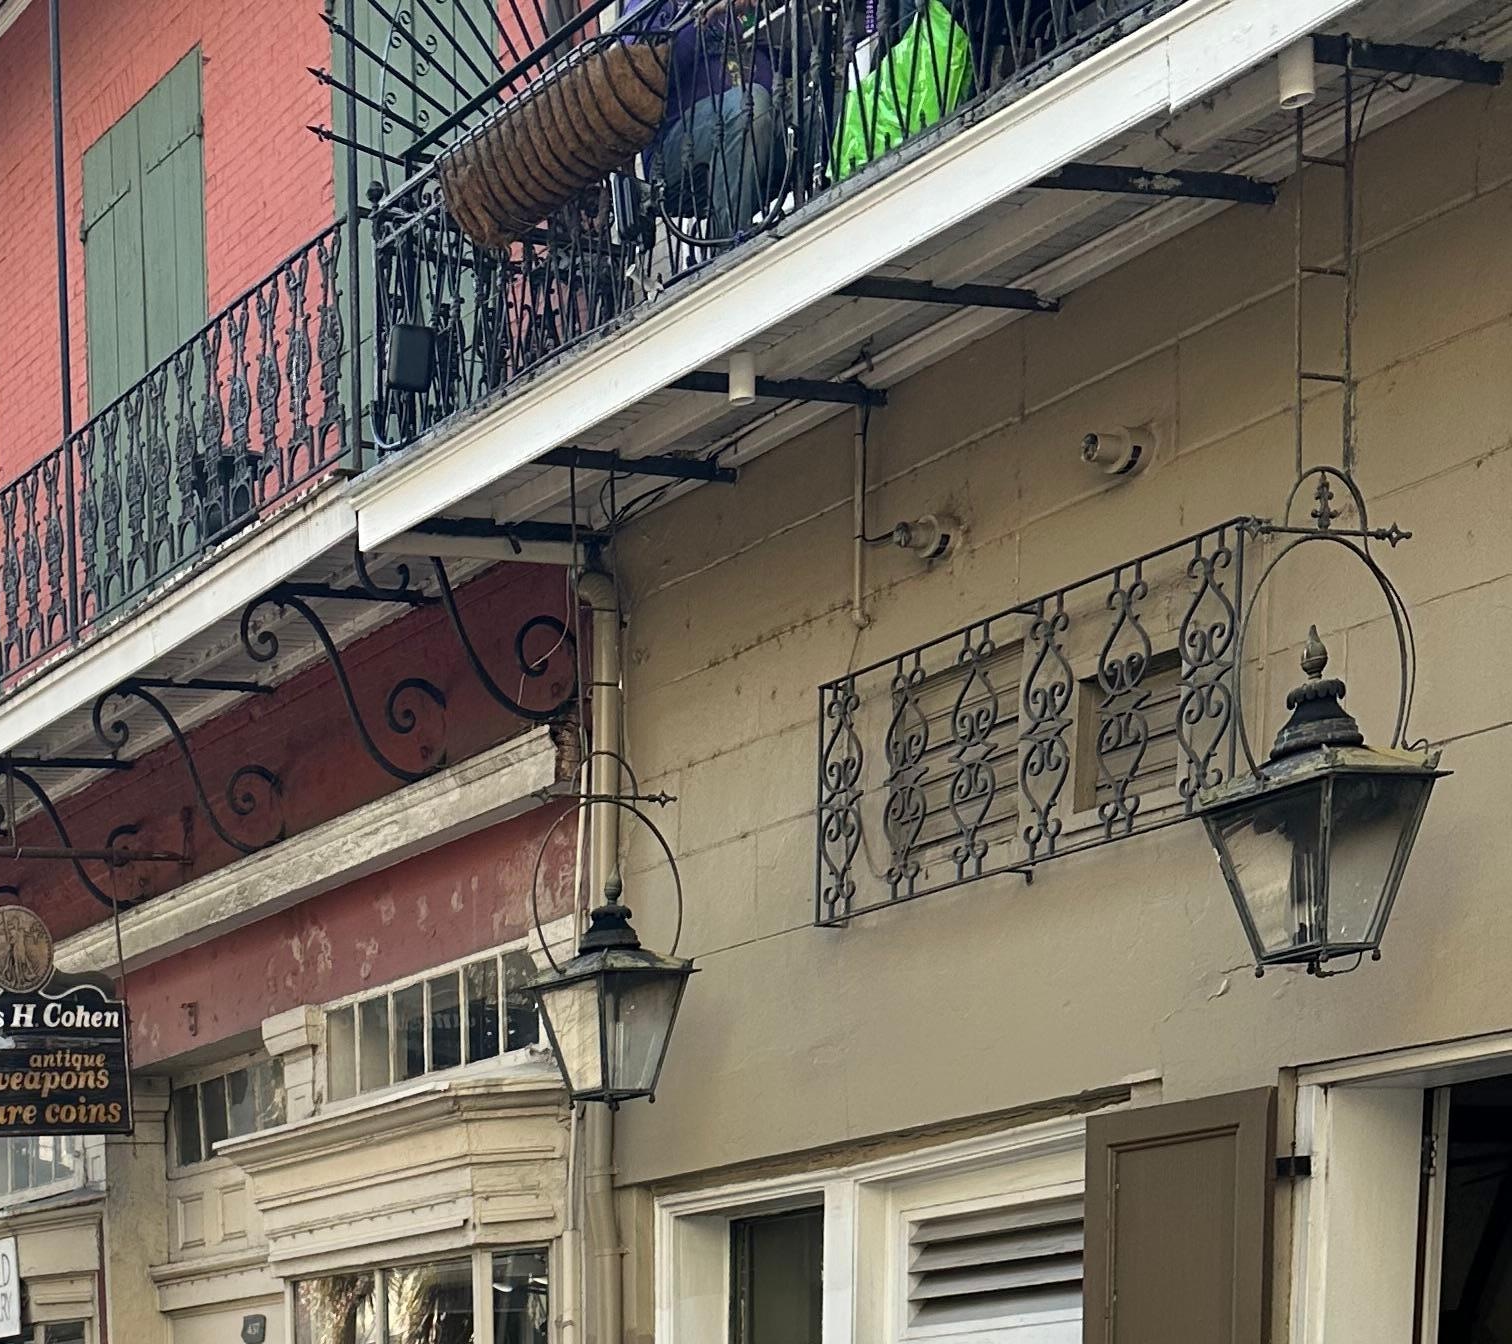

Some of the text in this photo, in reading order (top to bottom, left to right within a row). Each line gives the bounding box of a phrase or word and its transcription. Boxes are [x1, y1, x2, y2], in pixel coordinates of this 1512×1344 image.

[42, 1002, 119, 1028] Cohen
[29, 1050, 106, 1070] antique
[44, 1096, 122, 1125] coins
